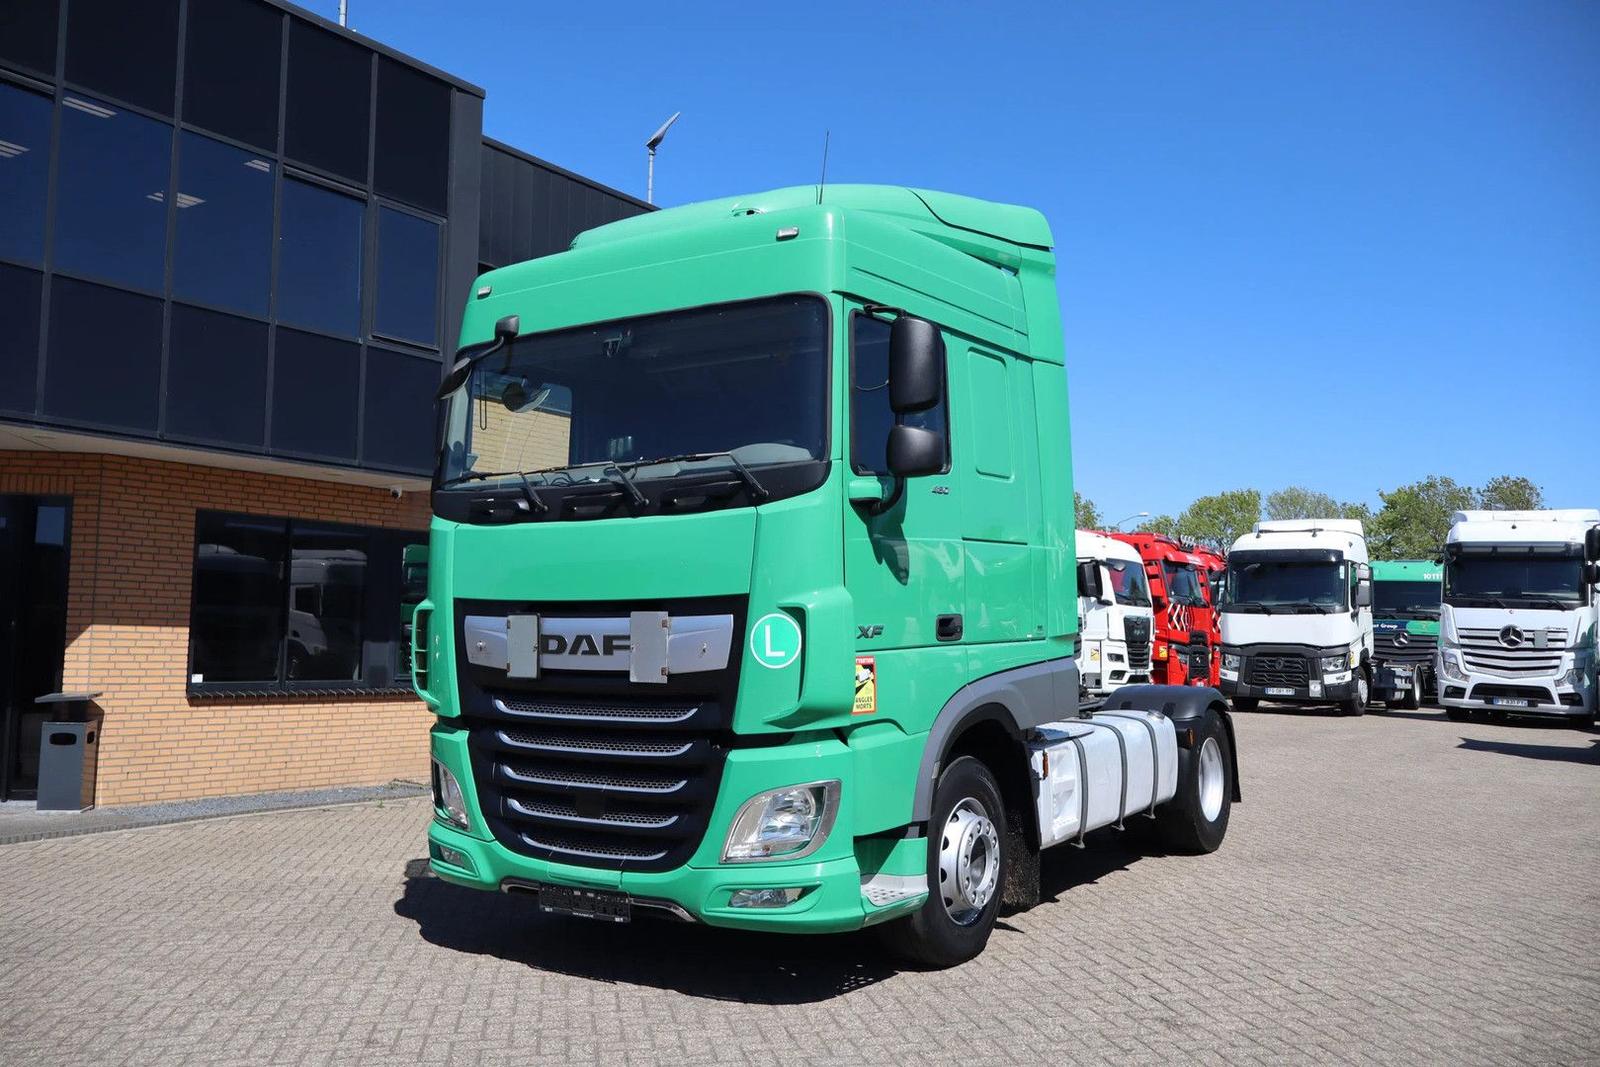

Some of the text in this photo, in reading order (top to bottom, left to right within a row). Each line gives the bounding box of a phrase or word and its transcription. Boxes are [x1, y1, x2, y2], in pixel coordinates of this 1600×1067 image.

[764, 624, 786, 657] L
[856, 625, 884, 639] XF
[540, 634, 631, 656] DAF
